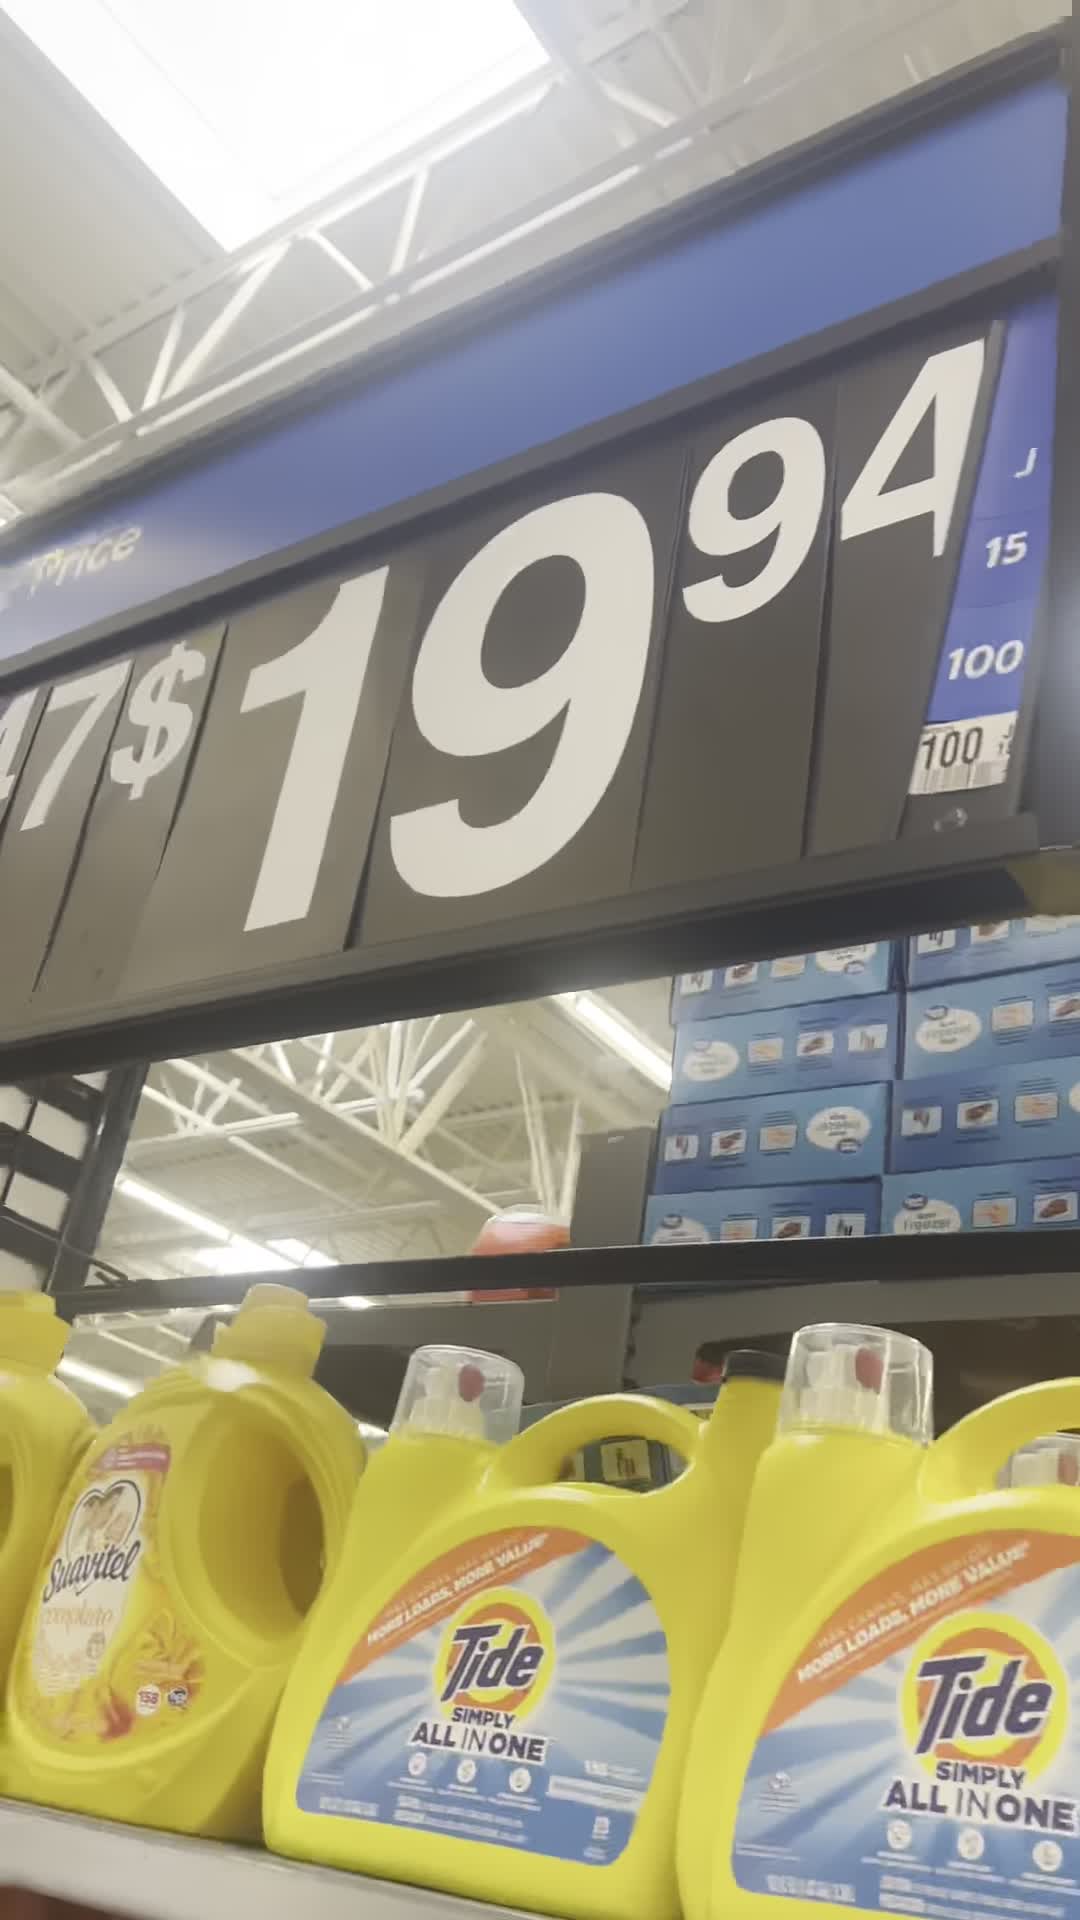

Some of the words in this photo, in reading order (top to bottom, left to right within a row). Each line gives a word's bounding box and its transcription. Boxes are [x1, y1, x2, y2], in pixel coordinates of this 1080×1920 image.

[1013, 447, 1038, 479] J
[986, 531, 1028, 569] 15
[948, 640, 1024, 680] 100
[922, 726, 983, 770] 100
[43, 1540, 142, 1604] Suavitel
[454, 1560, 496, 1591] MORE
[798, 1640, 848, 1682] MORE
[909, 1575, 963, 1616] MORE
[440, 1624, 545, 1702] Tide
[452, 1706, 516, 1730] SIMPLY
[915, 1656, 1053, 1755] Tide
[411, 1721, 457, 1749] ALL
[461, 1727, 487, 1752] IN
[488, 1732, 546, 1762] ONE
[936, 1760, 1026, 1790] SIMPLY
[884, 1779, 948, 1814] ALL
[956, 1787, 989, 1819] IN
[996, 1793, 1076, 1832] ONE
